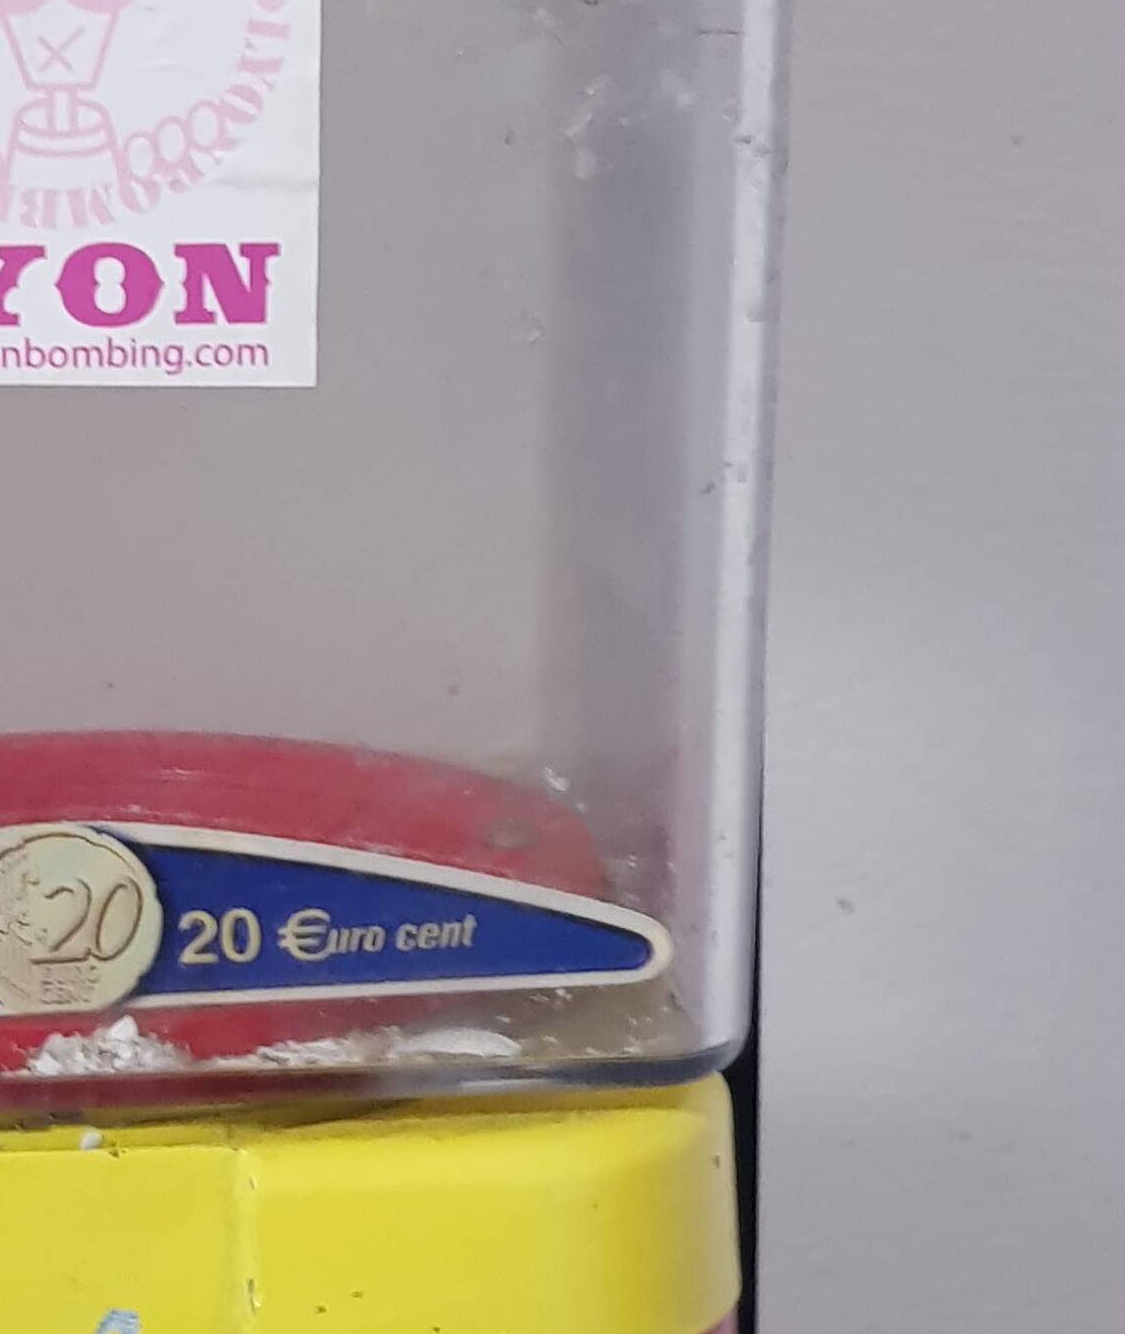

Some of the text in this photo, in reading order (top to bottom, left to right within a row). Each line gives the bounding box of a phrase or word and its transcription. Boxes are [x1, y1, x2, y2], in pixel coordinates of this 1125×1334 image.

[29, 877, 143, 964] 20
[177, 907, 262, 965] 20
[394, 913, 478, 952] cent
